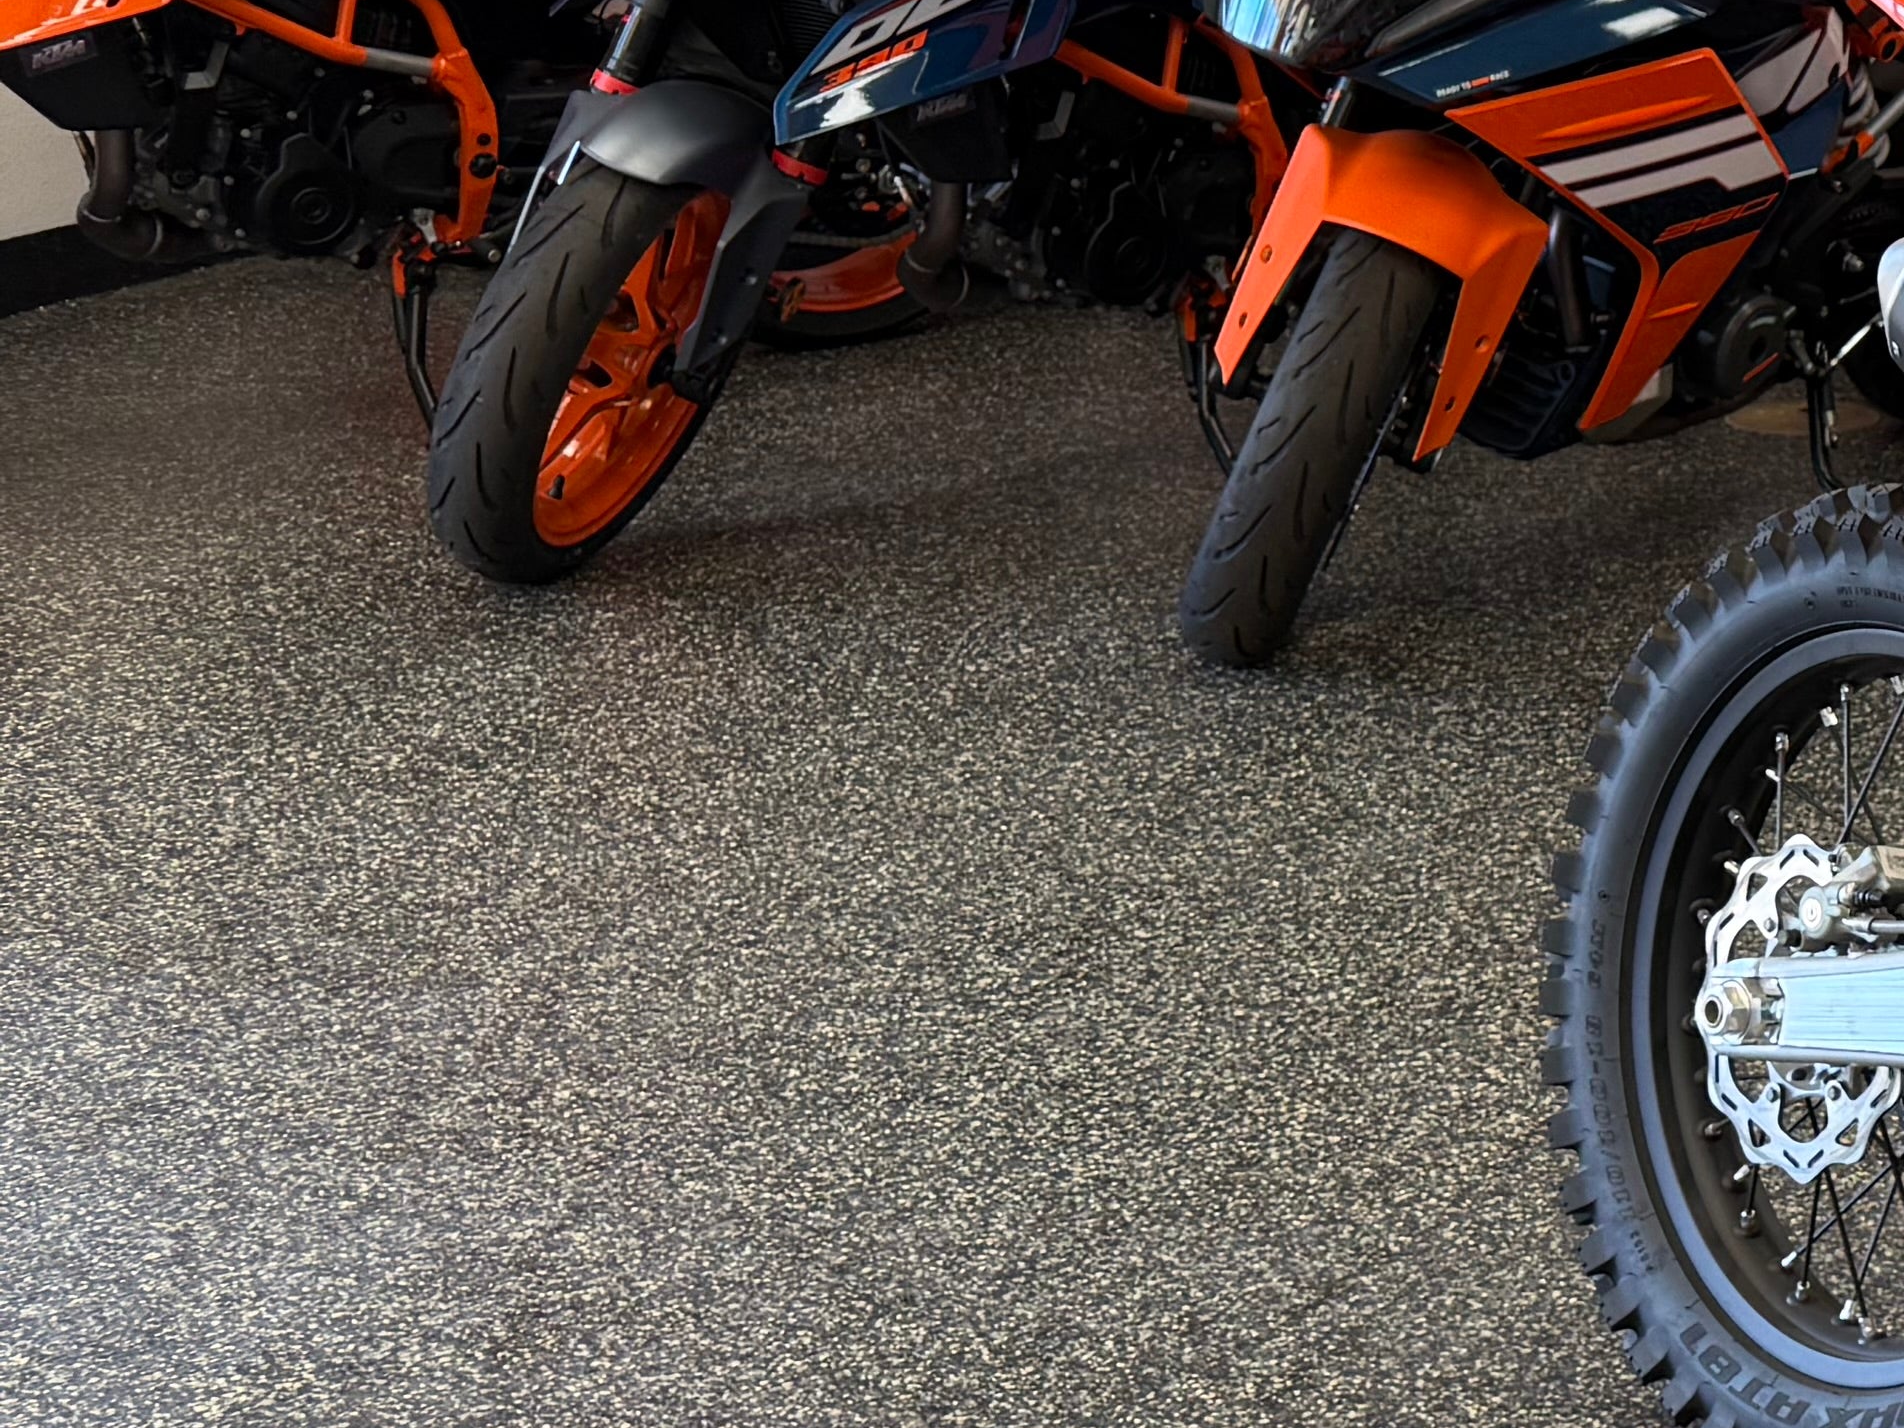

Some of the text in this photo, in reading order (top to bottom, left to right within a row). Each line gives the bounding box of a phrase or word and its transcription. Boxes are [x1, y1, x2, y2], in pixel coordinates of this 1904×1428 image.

[31, 38, 87, 70] KTM
[818, 28, 930, 93] 390
[1652, 191, 1779, 245] 390
